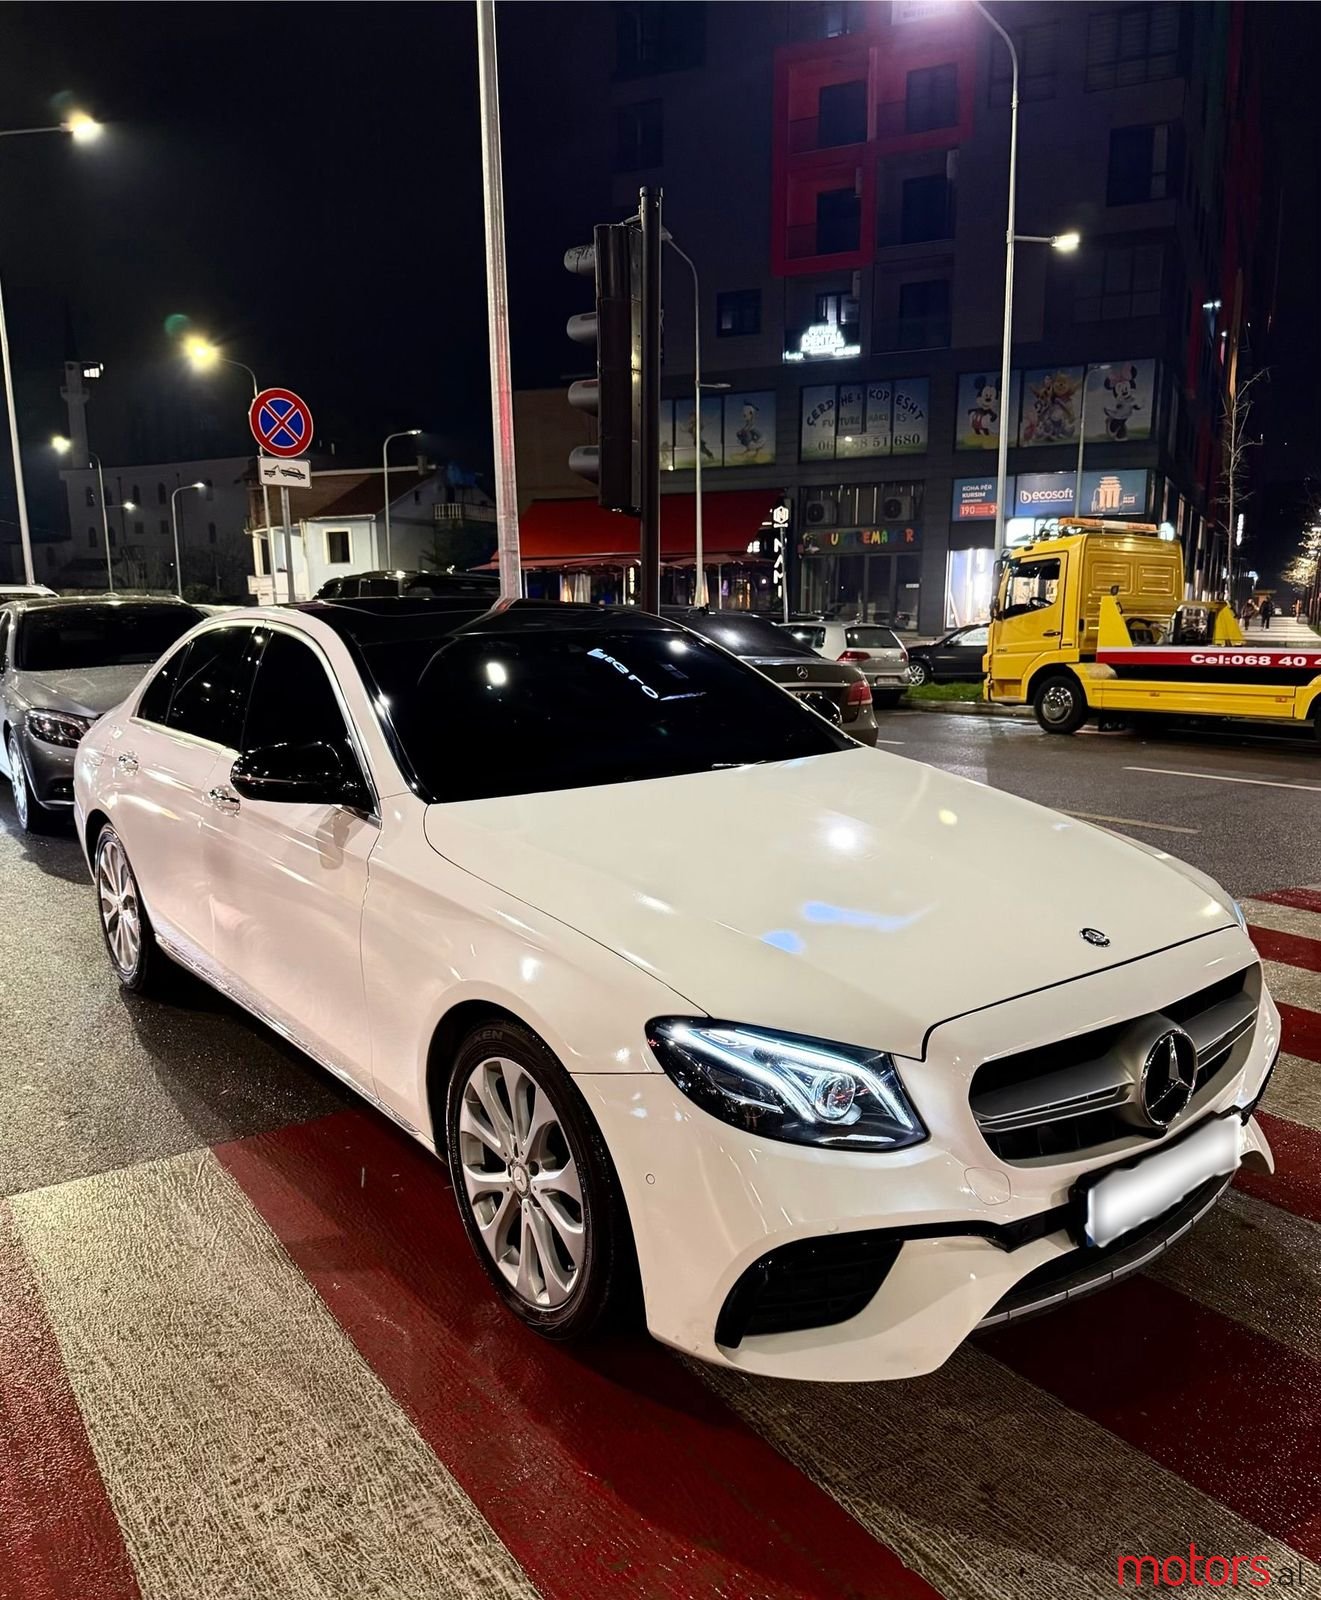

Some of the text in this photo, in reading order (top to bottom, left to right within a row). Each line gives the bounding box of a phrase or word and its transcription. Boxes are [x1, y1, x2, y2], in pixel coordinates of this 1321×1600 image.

[894, 433, 920, 446] 680
[1032, 488, 1073, 500] ecosoft
[961, 505, 975, 515] 190
[1191, 654, 1271, 665] Cel:068
[1278, 656, 1307, 666] 40
